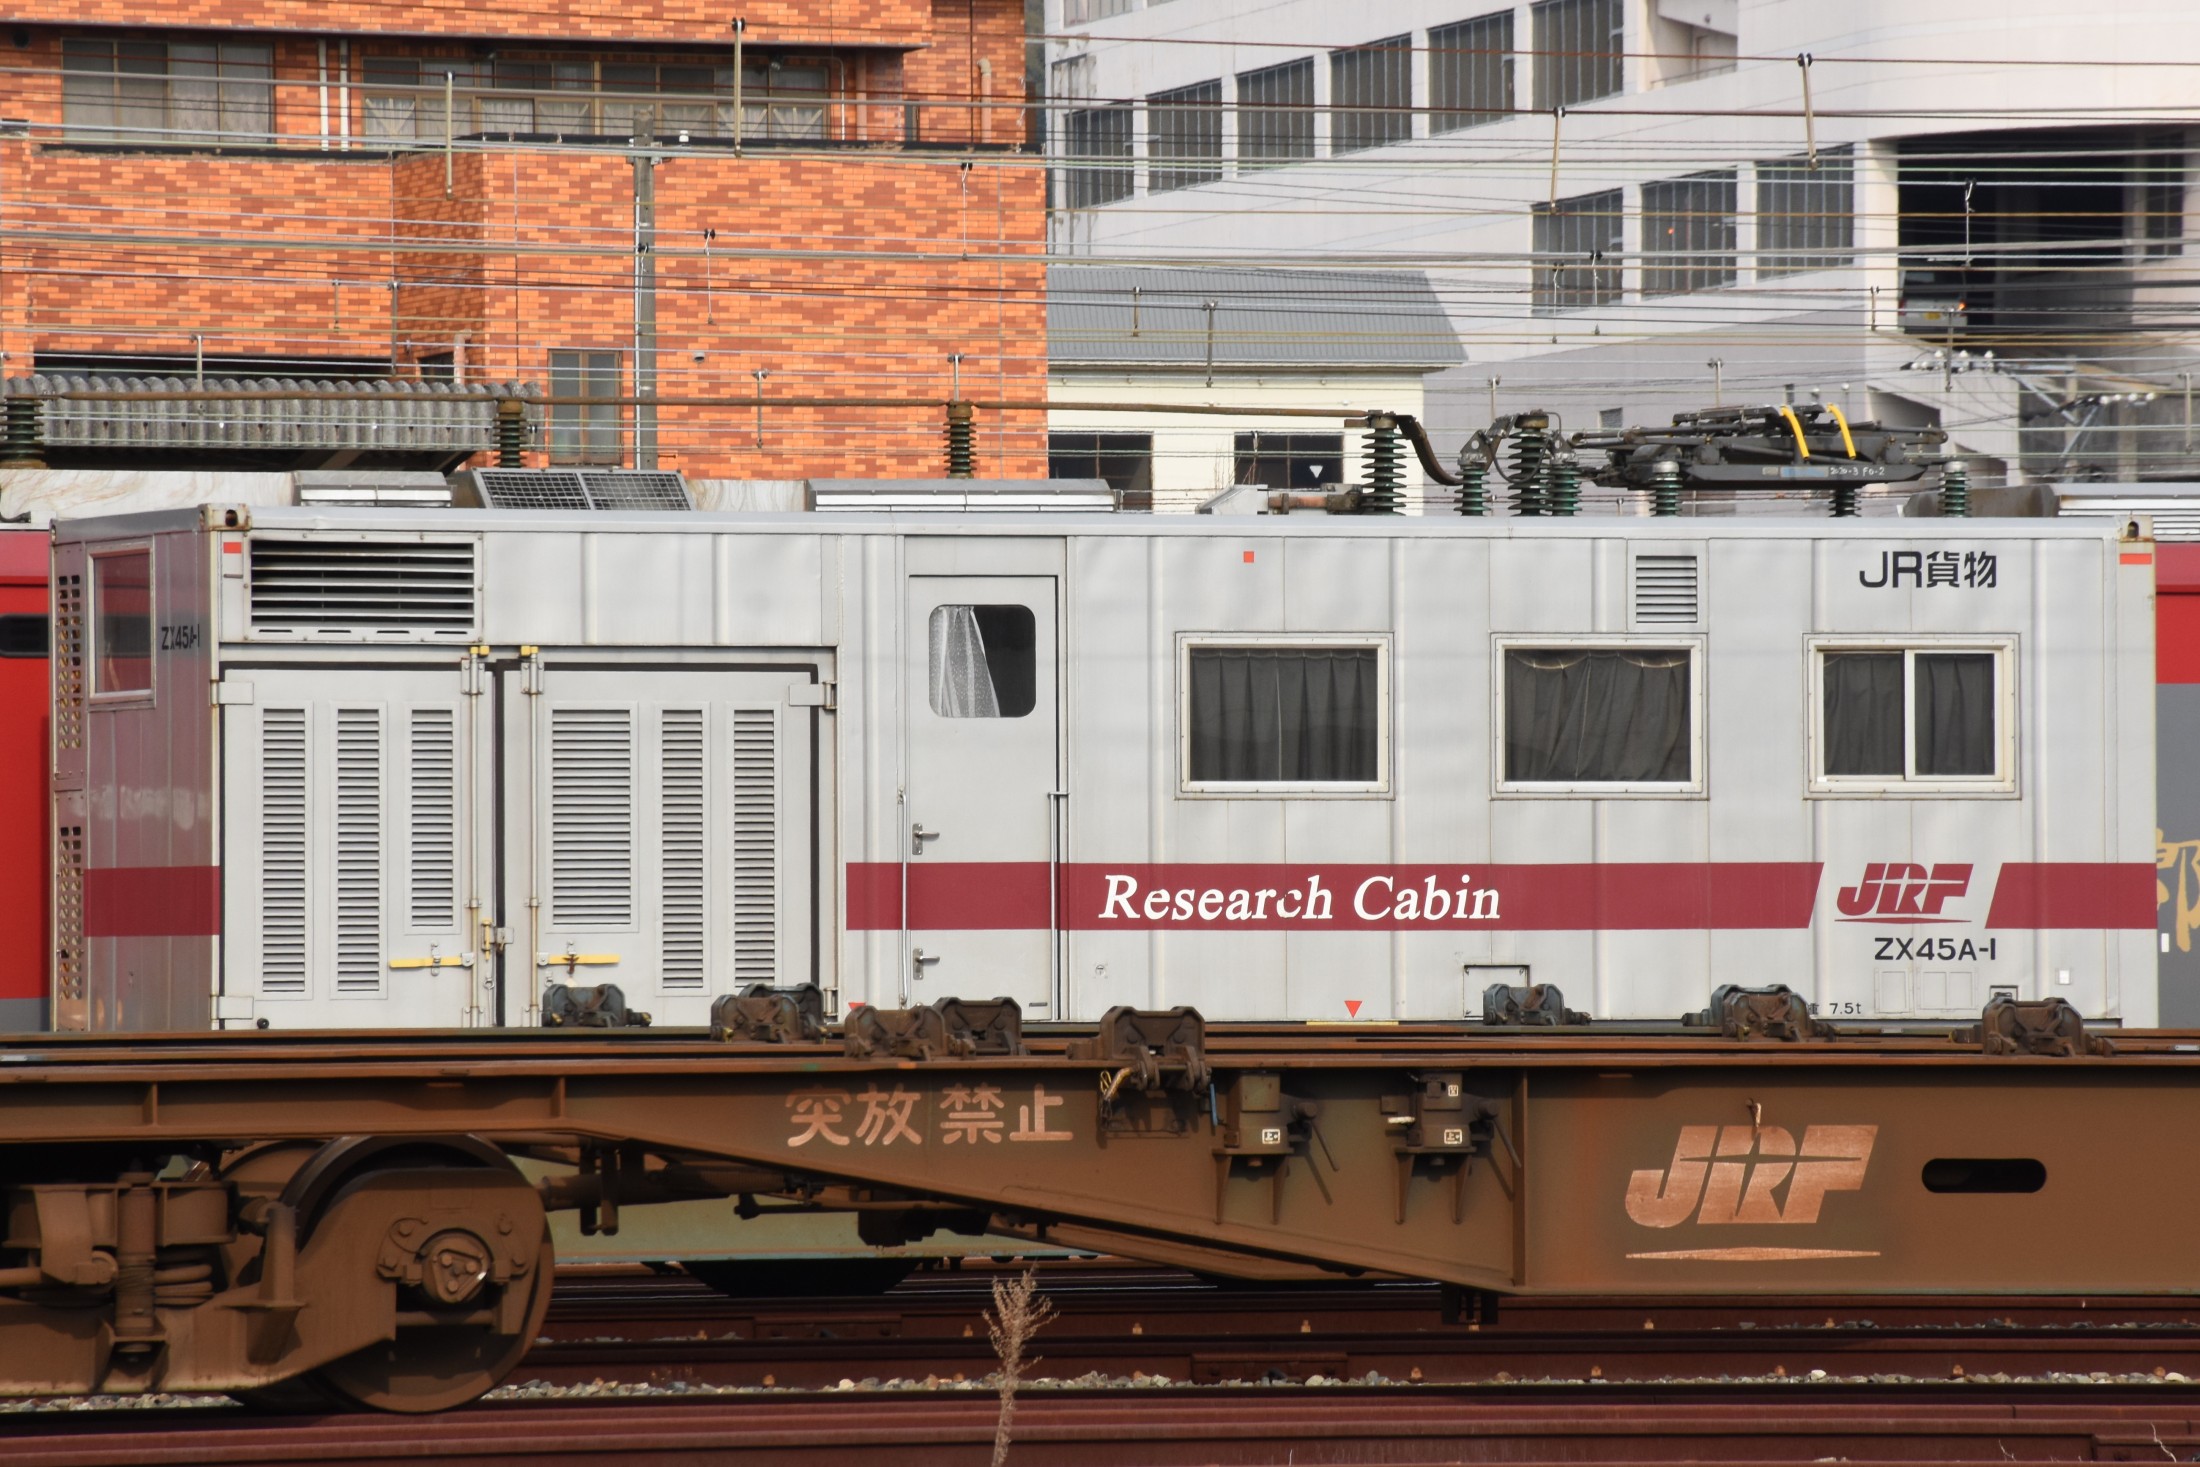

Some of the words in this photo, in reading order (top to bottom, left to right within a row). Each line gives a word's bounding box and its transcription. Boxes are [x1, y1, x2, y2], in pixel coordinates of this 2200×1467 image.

[1859, 551, 1997, 588] JR貨物
[1098, 874, 1333, 921] Research
[1353, 874, 1501, 921] Cabin
[1836, 863, 1974, 916] JRF
[1625, 1124, 1879, 1228] JRF
